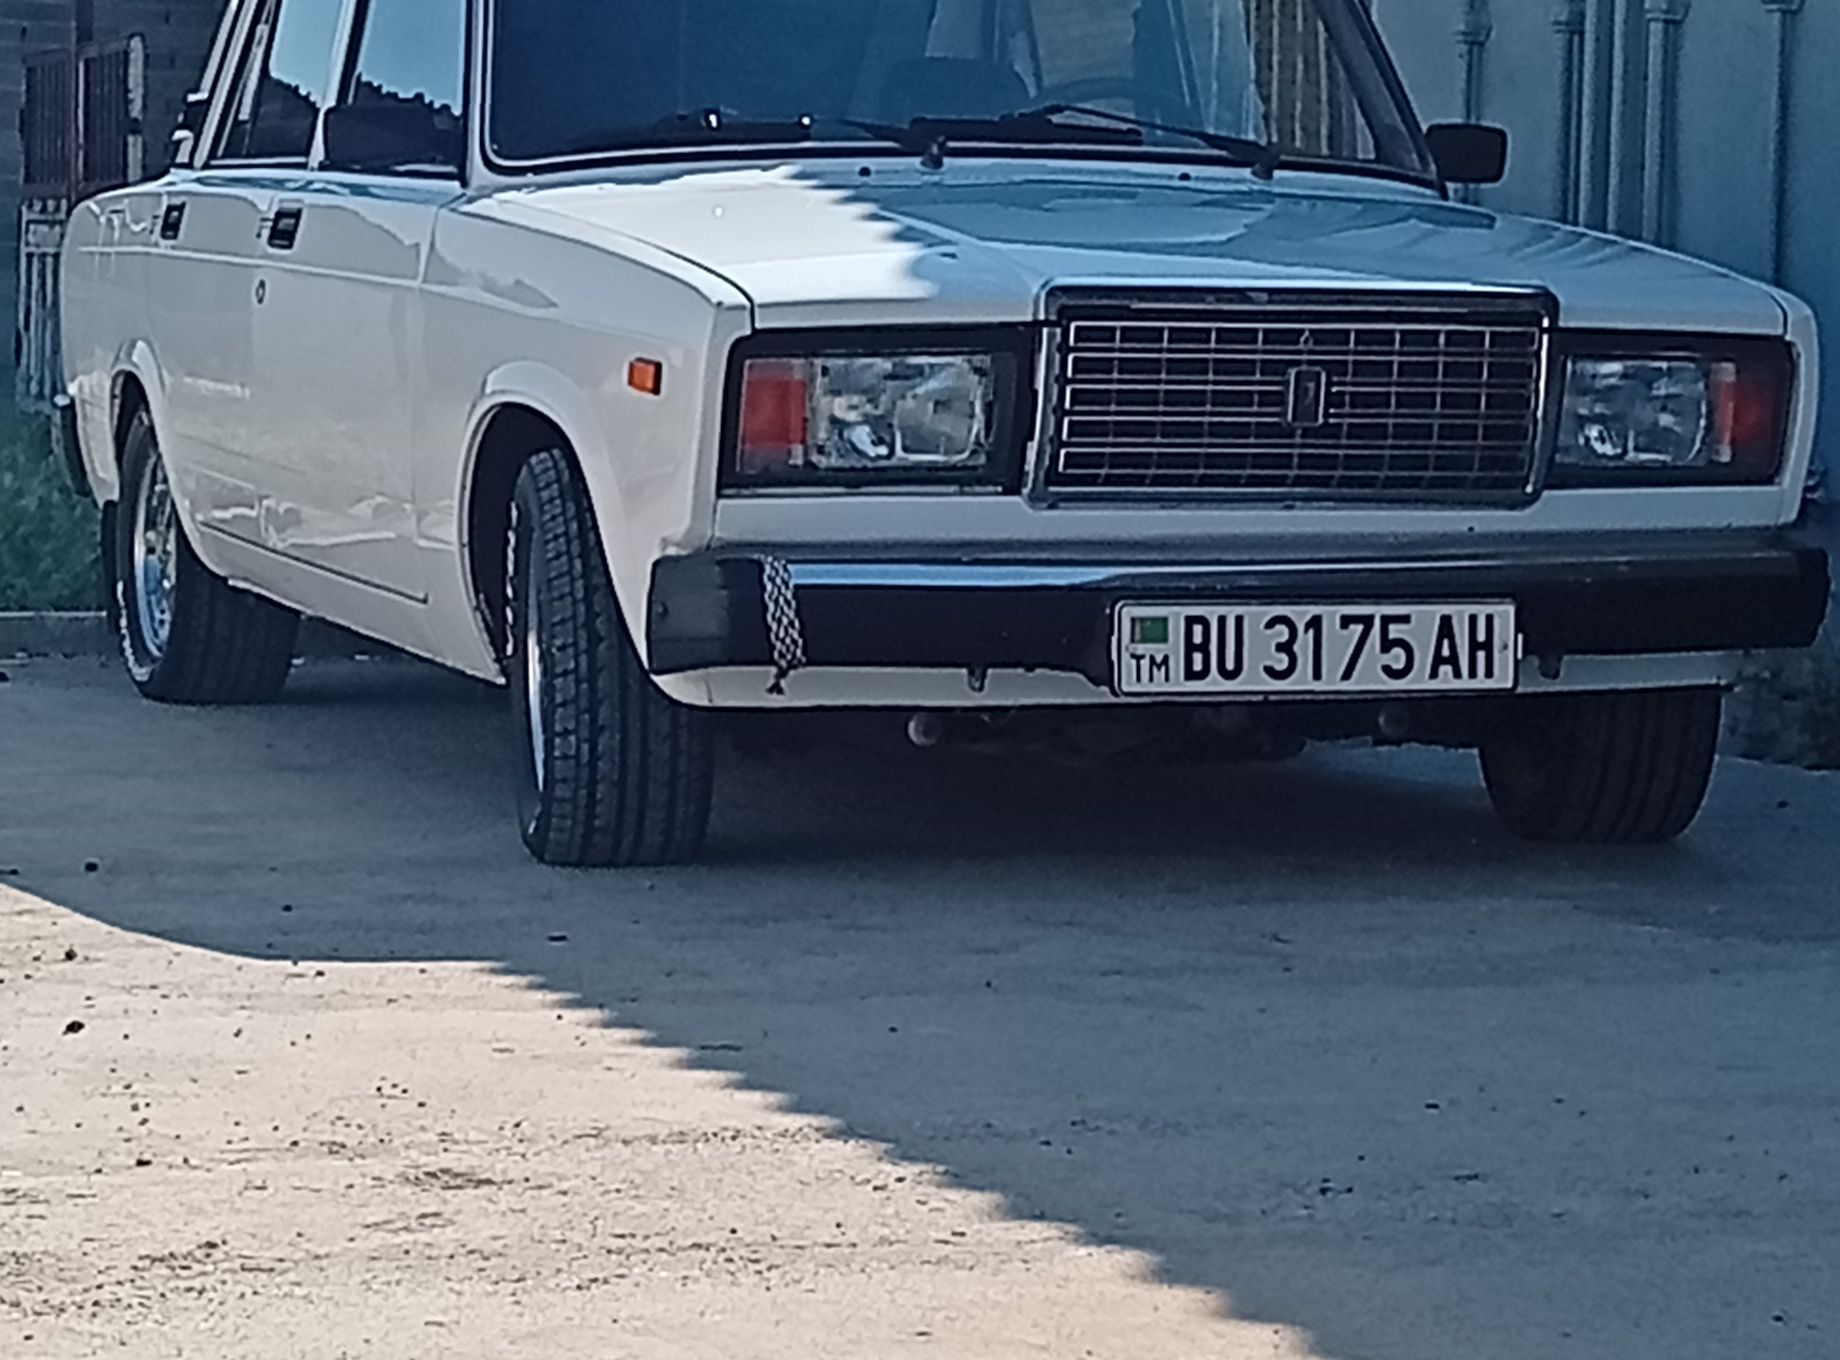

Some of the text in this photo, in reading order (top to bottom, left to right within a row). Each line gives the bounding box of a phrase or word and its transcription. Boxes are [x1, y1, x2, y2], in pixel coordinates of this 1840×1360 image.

[1130, 654, 1170, 683] TM
[1183, 613, 1495, 682] BU 3175 AH
